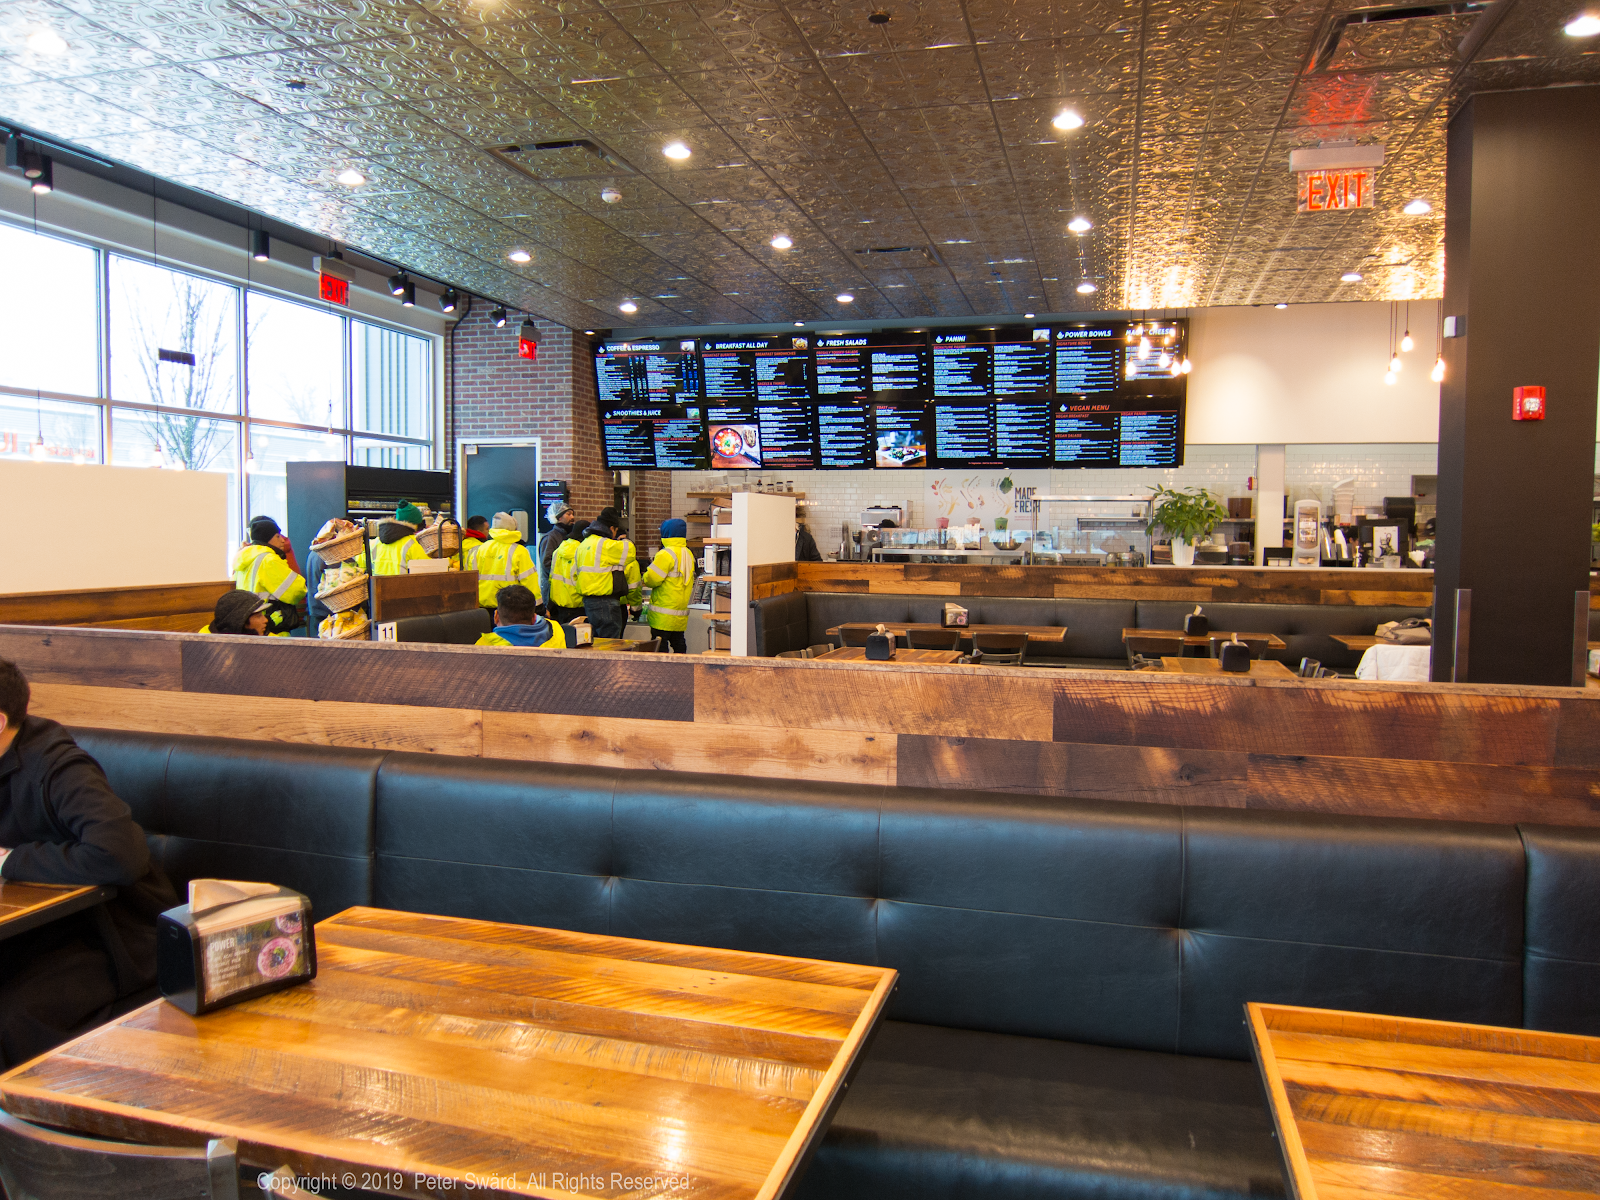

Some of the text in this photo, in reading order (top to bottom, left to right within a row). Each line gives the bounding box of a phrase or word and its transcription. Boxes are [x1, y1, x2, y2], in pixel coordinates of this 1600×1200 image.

[1307, 172, 1367, 210] EXIT
[323, 274, 348, 306] EXIT
[715, 342, 746, 350] BREAKFAST
[845, 338, 867, 346] SALADS
[1014, 487, 1037, 500] MADE
[1014, 500, 1041, 513] FRESH
[382, 626, 394, 639] 11
[209, 937, 235, 951] POWER
